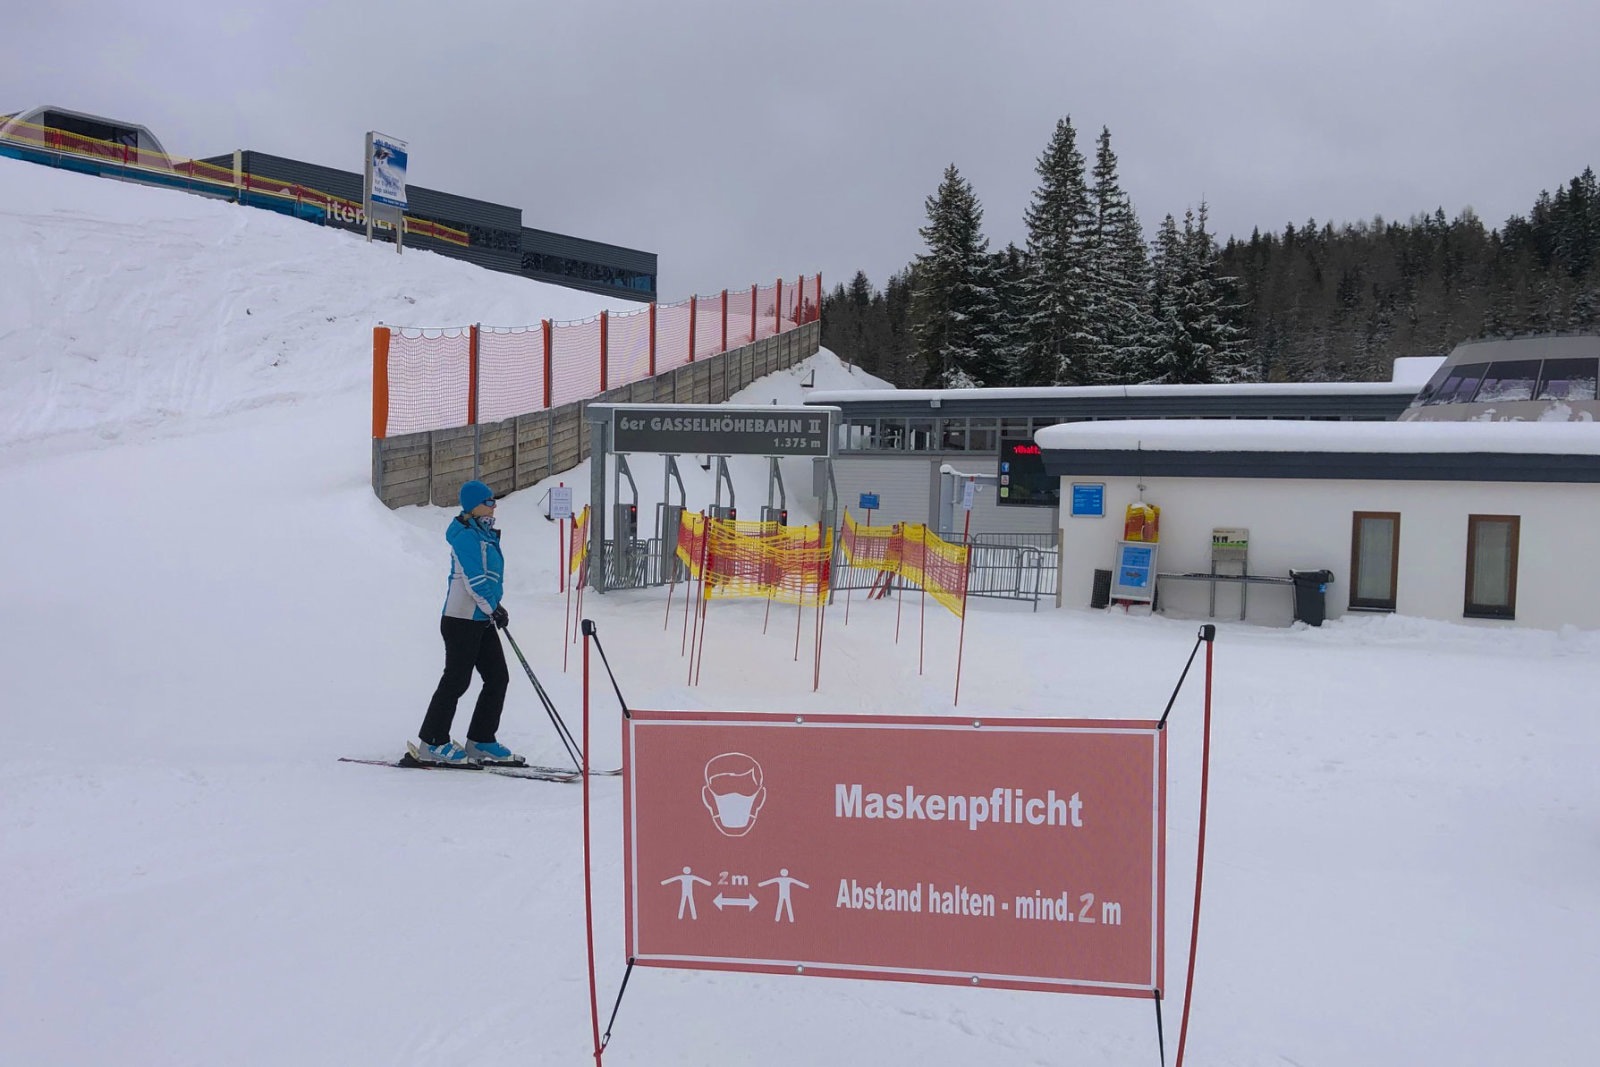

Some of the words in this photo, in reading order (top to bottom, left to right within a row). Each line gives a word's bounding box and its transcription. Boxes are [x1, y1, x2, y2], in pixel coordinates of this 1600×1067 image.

[619, 416, 646, 430] 6er
[650, 415, 802, 433] GASSELHÖHEBAHN
[808, 419, 821, 434] II
[773, 437, 807, 448] 1.375
[810, 439, 821, 448] m
[834, 783, 1084, 831] Maskenpflicht
[718, 871, 728, 886] 2
[731, 873, 749, 886] m
[836, 878, 922, 913] Abstand
[928, 884, 995, 917] halten
[1015, 890, 1074, 922] mind.
[1077, 892, 1096, 923] 2
[1102, 901, 1122, 925] m
